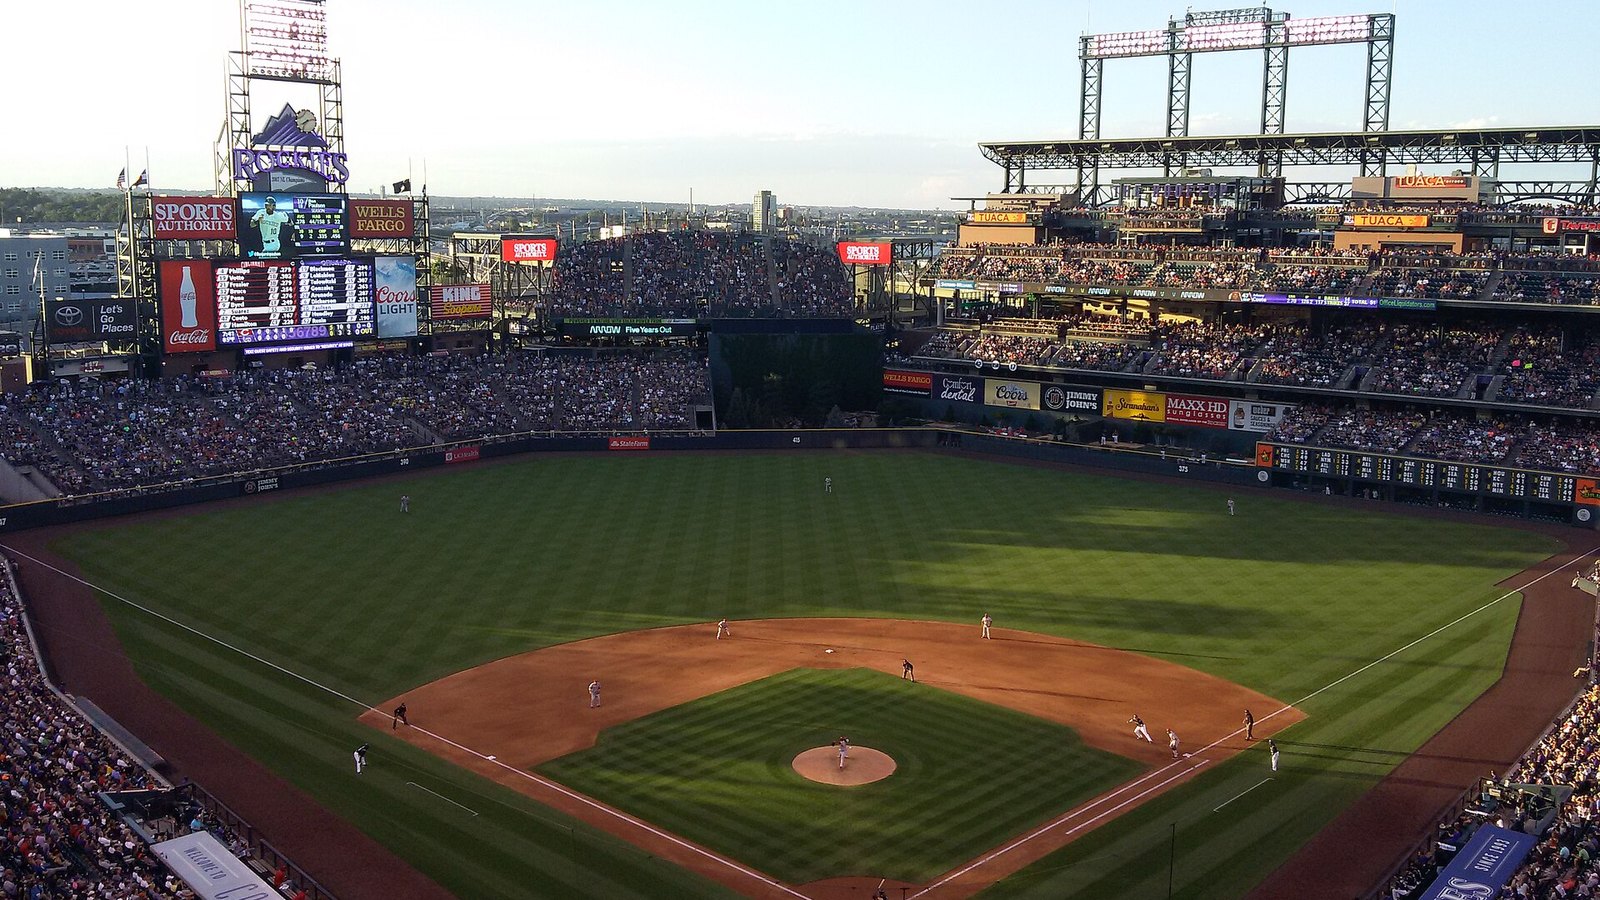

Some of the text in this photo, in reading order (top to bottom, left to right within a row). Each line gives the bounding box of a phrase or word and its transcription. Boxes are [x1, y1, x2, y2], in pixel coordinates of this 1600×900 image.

[233, 148, 350, 184] ROCKIES
[1396, 176, 1445, 186] TUACA
[1153, 183, 1228, 198] ROOFTOP
[155, 204, 232, 220] SPORTS
[355, 206, 406, 218] WELLS
[978, 214, 1010, 222] TUACA
[1361, 216, 1404, 226] TUACA
[156, 220, 232, 231] AUTHORITY
[356, 219, 406, 232] FARGO
[514, 243, 547, 253] SPORTS
[846, 246, 879, 255] SPORTS
[375, 286, 416, 304] Coors
[442, 286, 481, 302] KING
[444, 302, 482, 316] Soopers
[1379, 299, 1435, 308] OfficeLiquidators.com
[100, 305, 123, 314] Let's
[380, 304, 414, 315] LIGHT
[100, 315, 114, 324] Go
[101, 324, 134, 334] Places
[884, 374, 931, 384] WELLS FARGO
[942, 377, 972, 390] Comfort
[940, 387, 976, 402] dental
[996, 385, 1028, 401] Coors
[1066, 391, 1098, 401] JIMMY
[1066, 400, 1098, 410] JOHN'S
[1115, 397, 1160, 412] Stranahan's
[1167, 398, 1227, 413] MAXX HD
[1167, 409, 1226, 420] sunglasses
[257, 477, 278, 486] JIMMY
[1474, 838, 1511, 872] SINCE 1993
[183, 848, 227, 881] WELCOME TO
